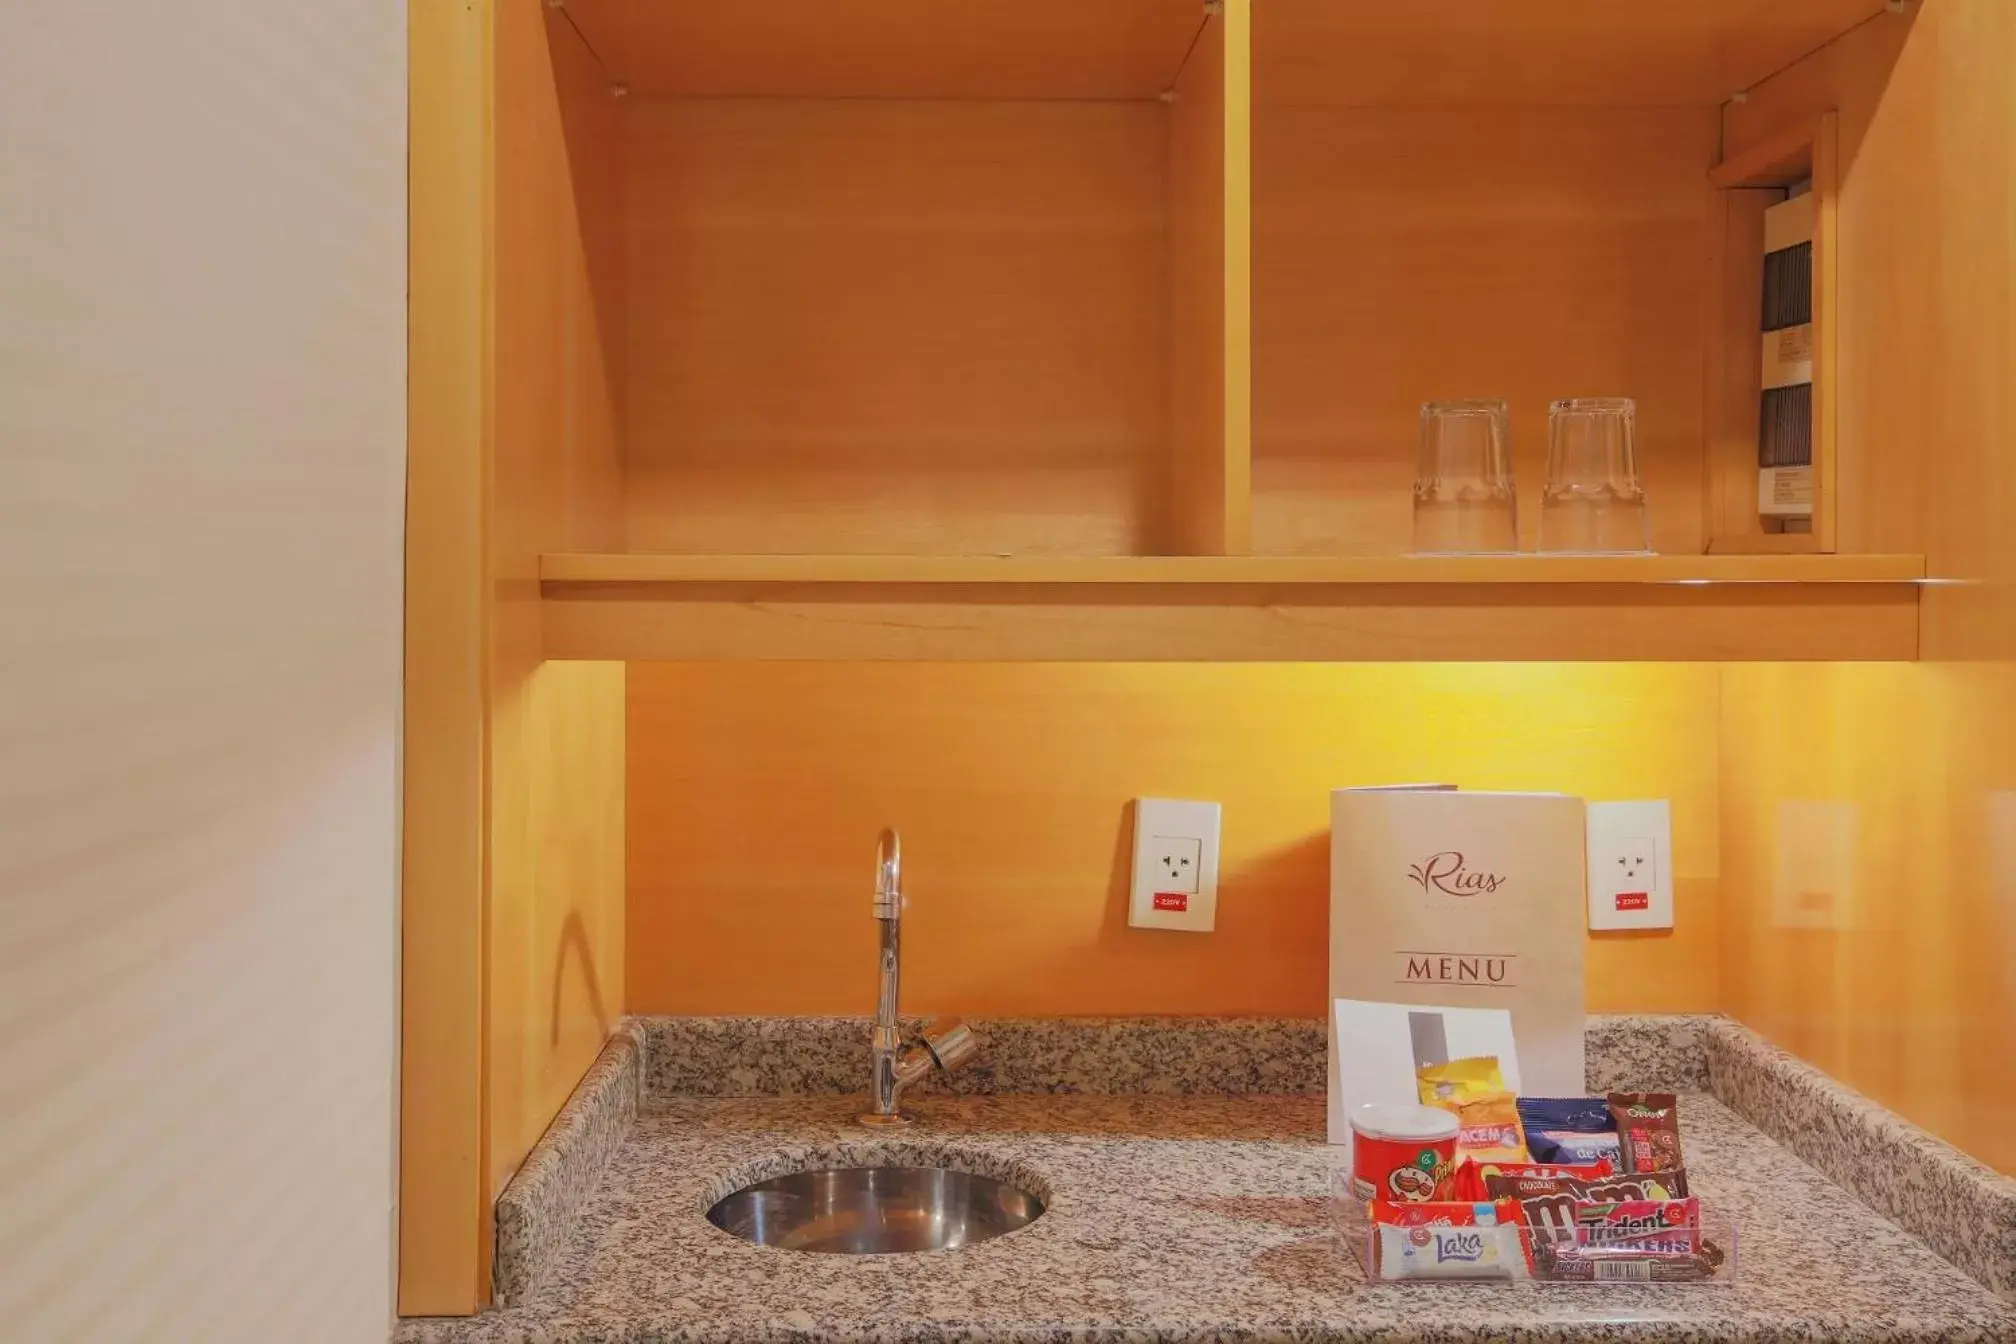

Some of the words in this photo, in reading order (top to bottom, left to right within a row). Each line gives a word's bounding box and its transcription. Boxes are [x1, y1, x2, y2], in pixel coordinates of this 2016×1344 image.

[1408, 851, 1506, 897] Rias
[1406, 957, 1506, 982] MENU
[1579, 1209, 1676, 1242] Trident
[1435, 1232, 1484, 1264] Laka
